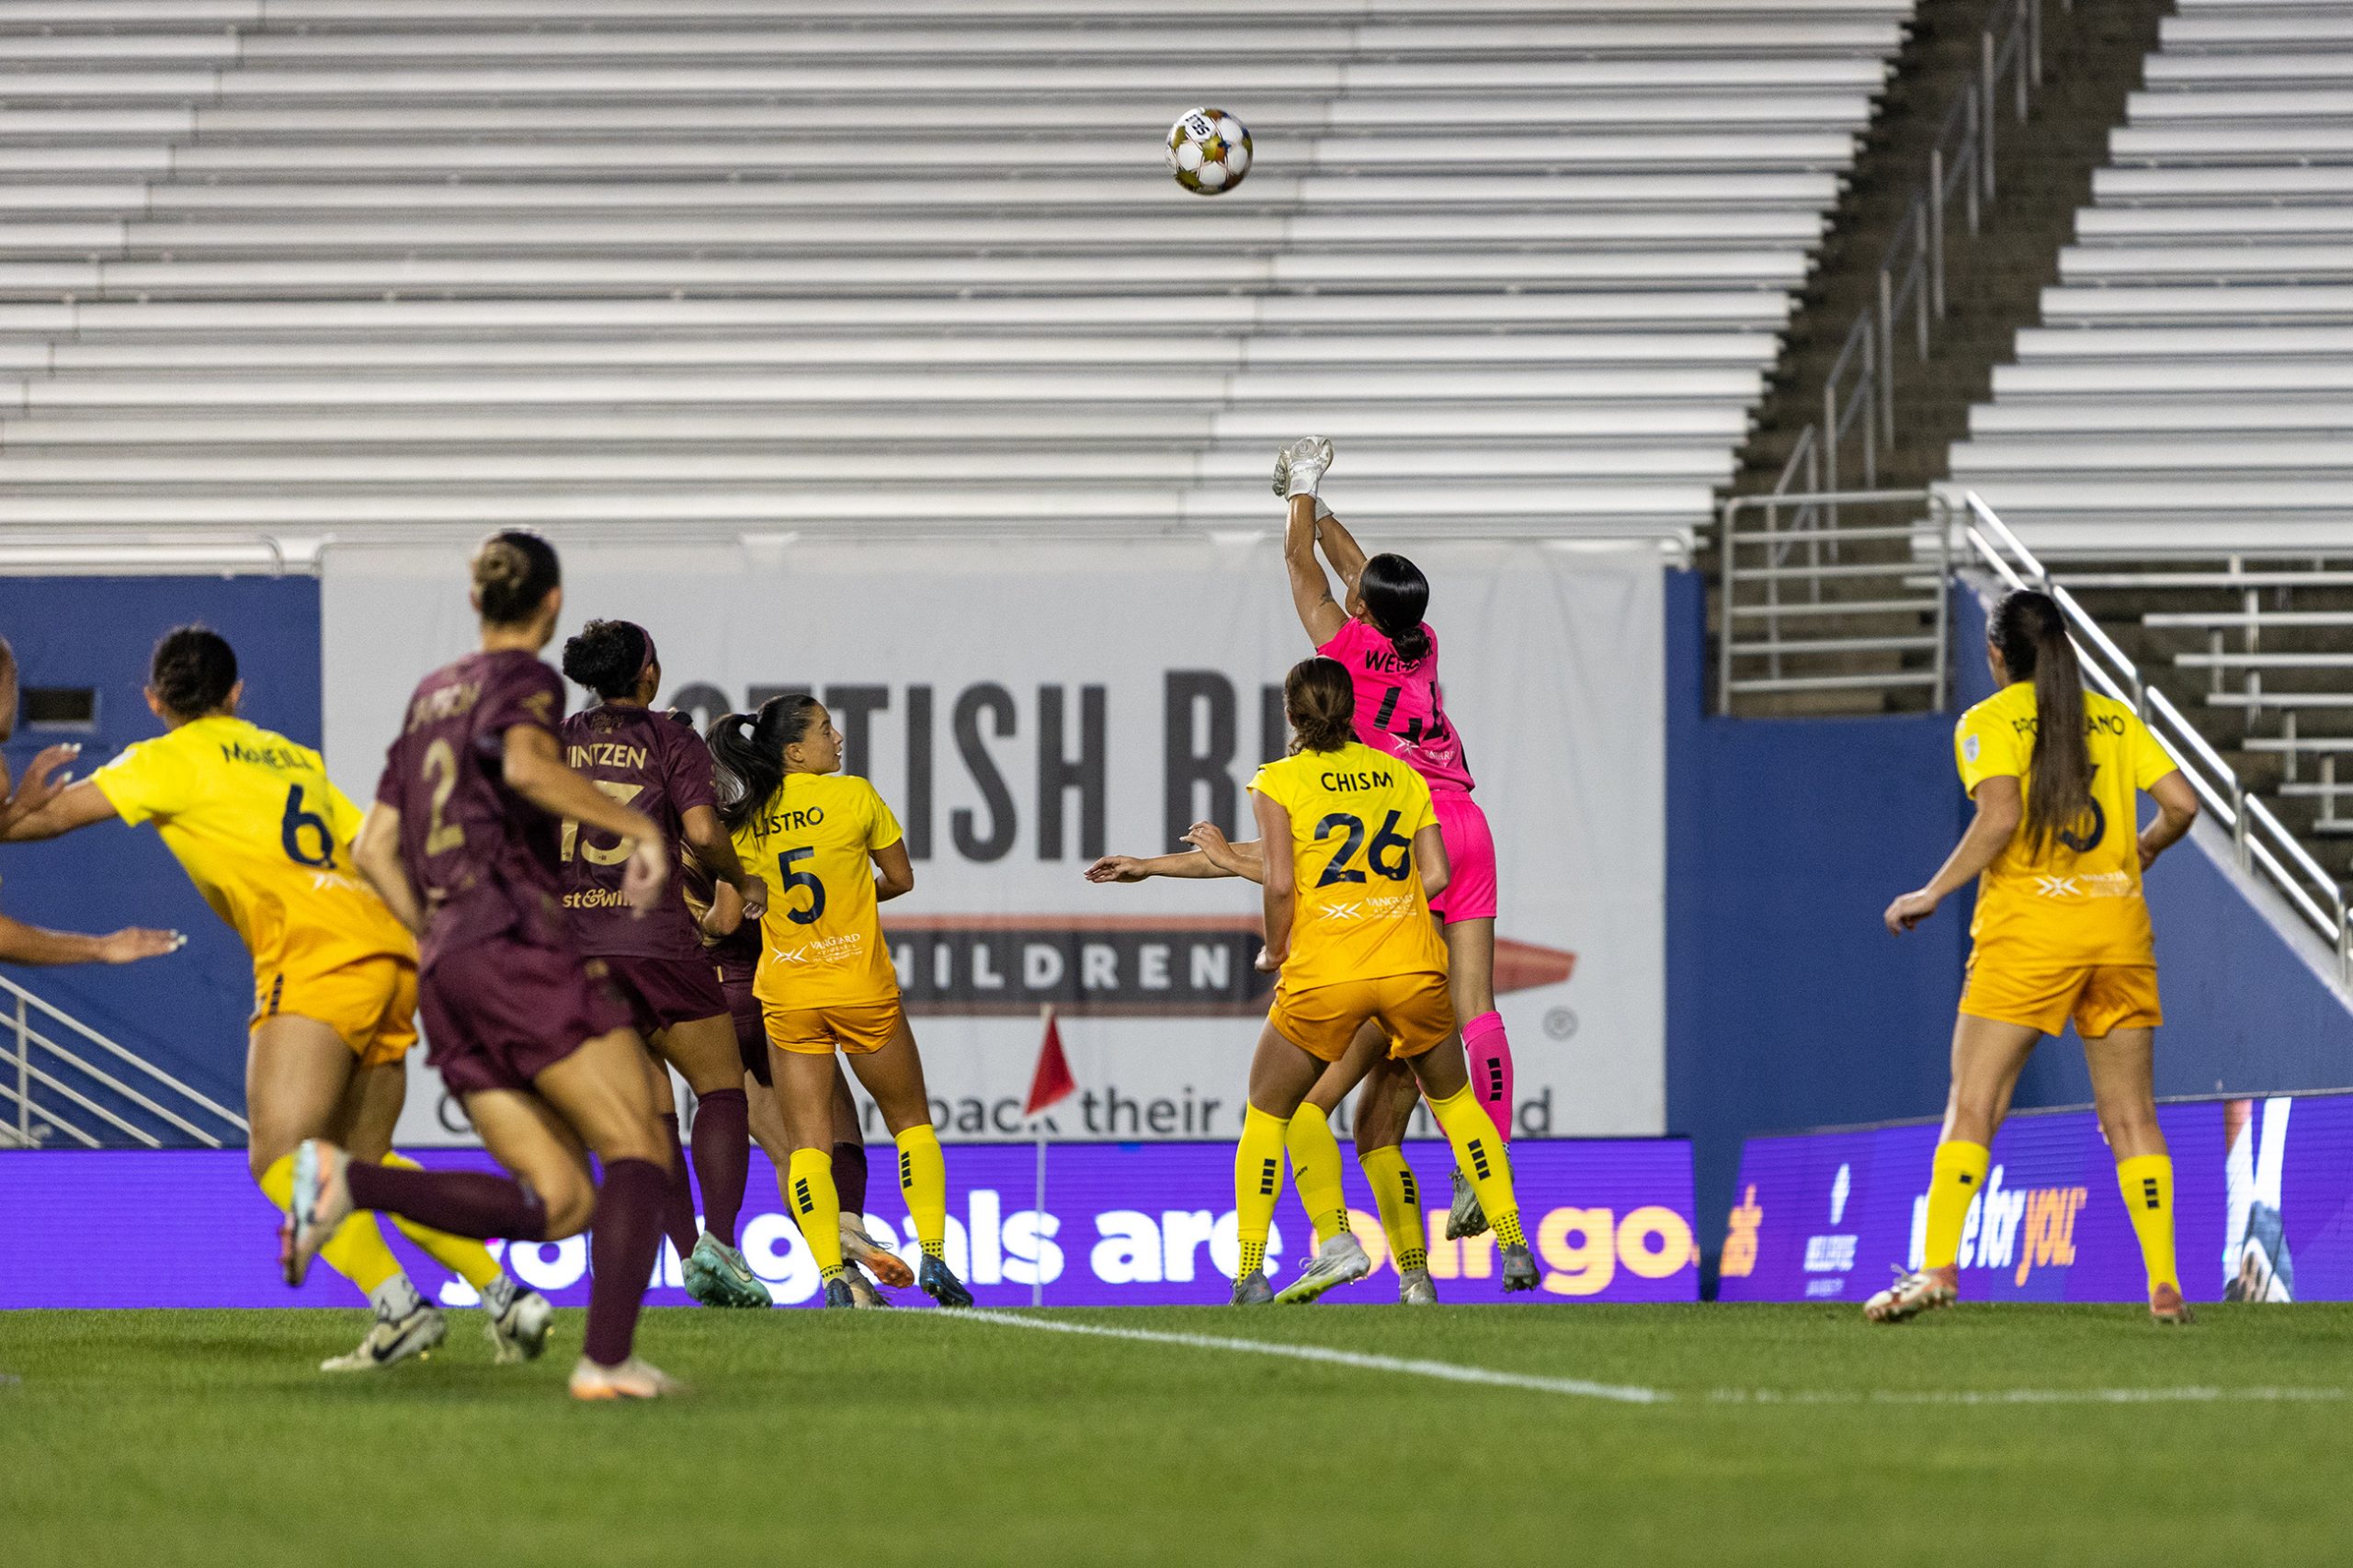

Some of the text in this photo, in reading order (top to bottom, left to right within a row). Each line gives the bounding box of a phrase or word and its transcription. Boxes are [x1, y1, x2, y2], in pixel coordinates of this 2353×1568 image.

[566, 743, 647, 770] INTZEN
[1321, 771, 1393, 792] CHISM
[281, 783, 337, 869] 6
[423, 738, 465, 857] 2
[1314, 810, 1412, 889] 26
[778, 846, 826, 926] 5
[810, 933, 860, 950] VANGARD
[888, 944, 1230, 990] HILDREN
[1081, 1086, 1221, 1135] their
[1537, 1206, 1700, 1296] go
